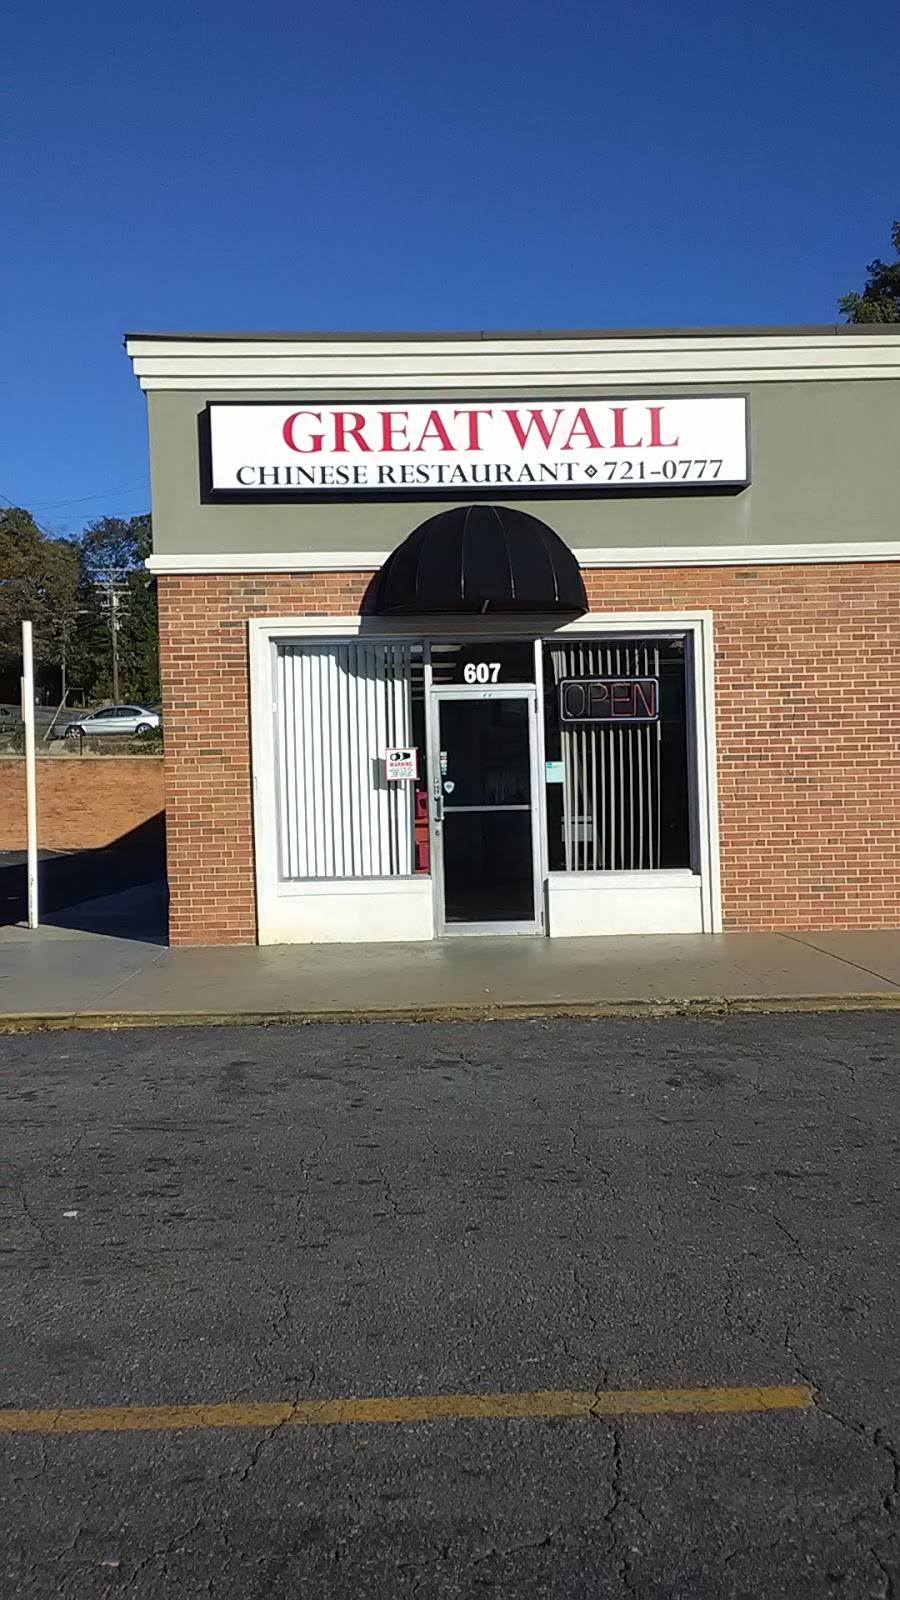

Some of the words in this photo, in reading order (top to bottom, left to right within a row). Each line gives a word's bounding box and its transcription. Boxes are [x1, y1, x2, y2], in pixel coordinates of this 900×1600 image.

[282, 409, 493, 453] GREAT
[501, 406, 680, 451] WALL
[235, 464, 368, 486] CHINESE
[376, 462, 580, 485] RESTAURANT
[603, 459, 724, 481] 721-0777
[463, 662, 501, 684] 607
[564, 682, 655, 717] OPEN
